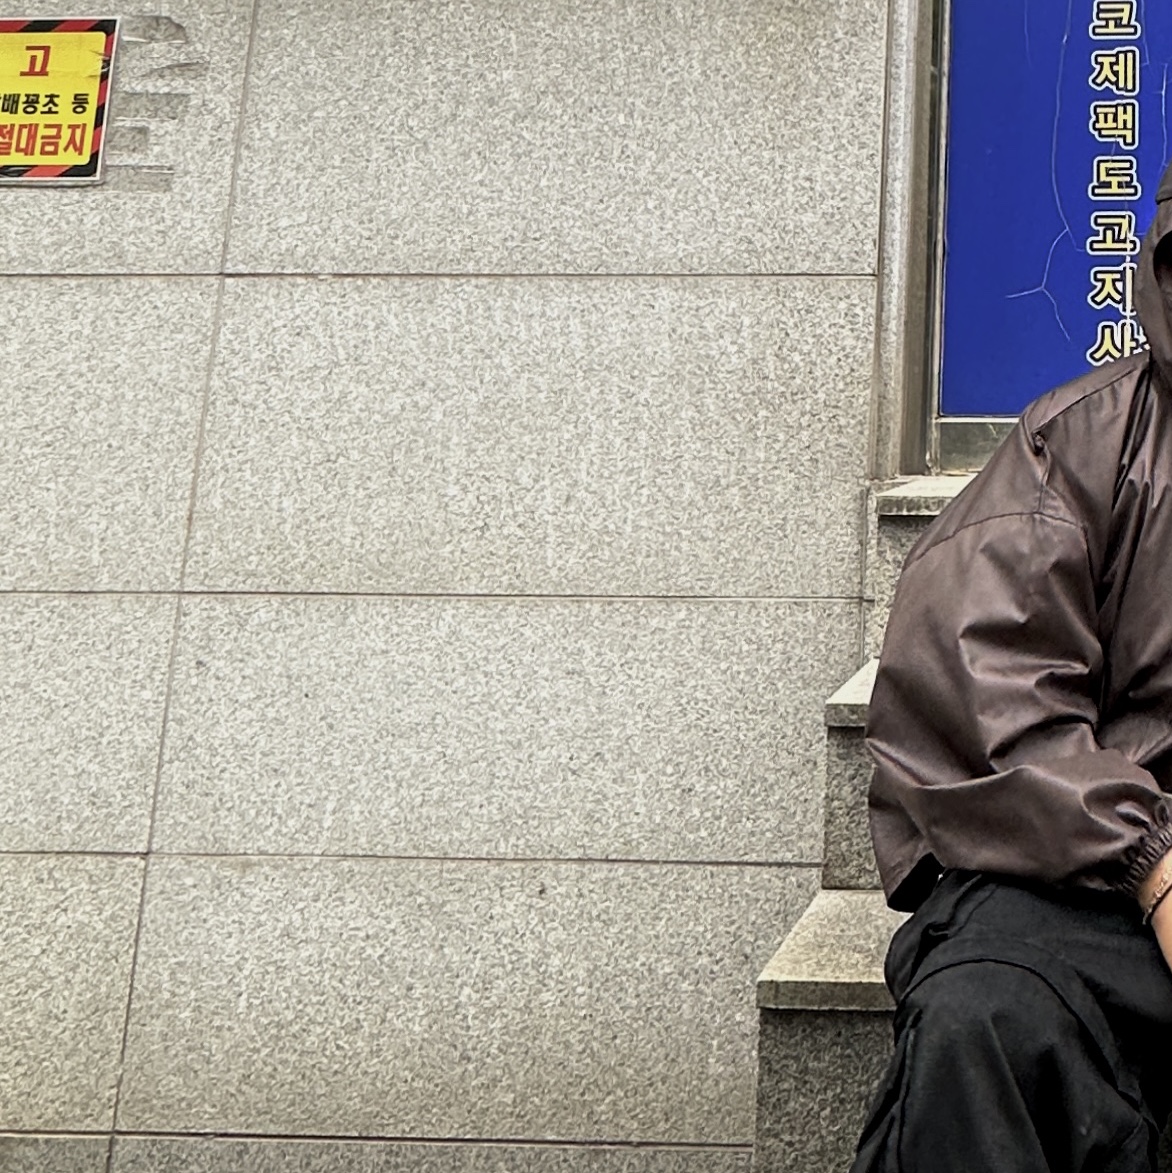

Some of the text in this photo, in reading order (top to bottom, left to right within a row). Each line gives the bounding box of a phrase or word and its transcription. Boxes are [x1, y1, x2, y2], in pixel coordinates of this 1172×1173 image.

[20, 45, 51, 77] 고
[0, 93, 90, 115] 배꽁초 등
[0, 123, 87, 156] 절대금지
